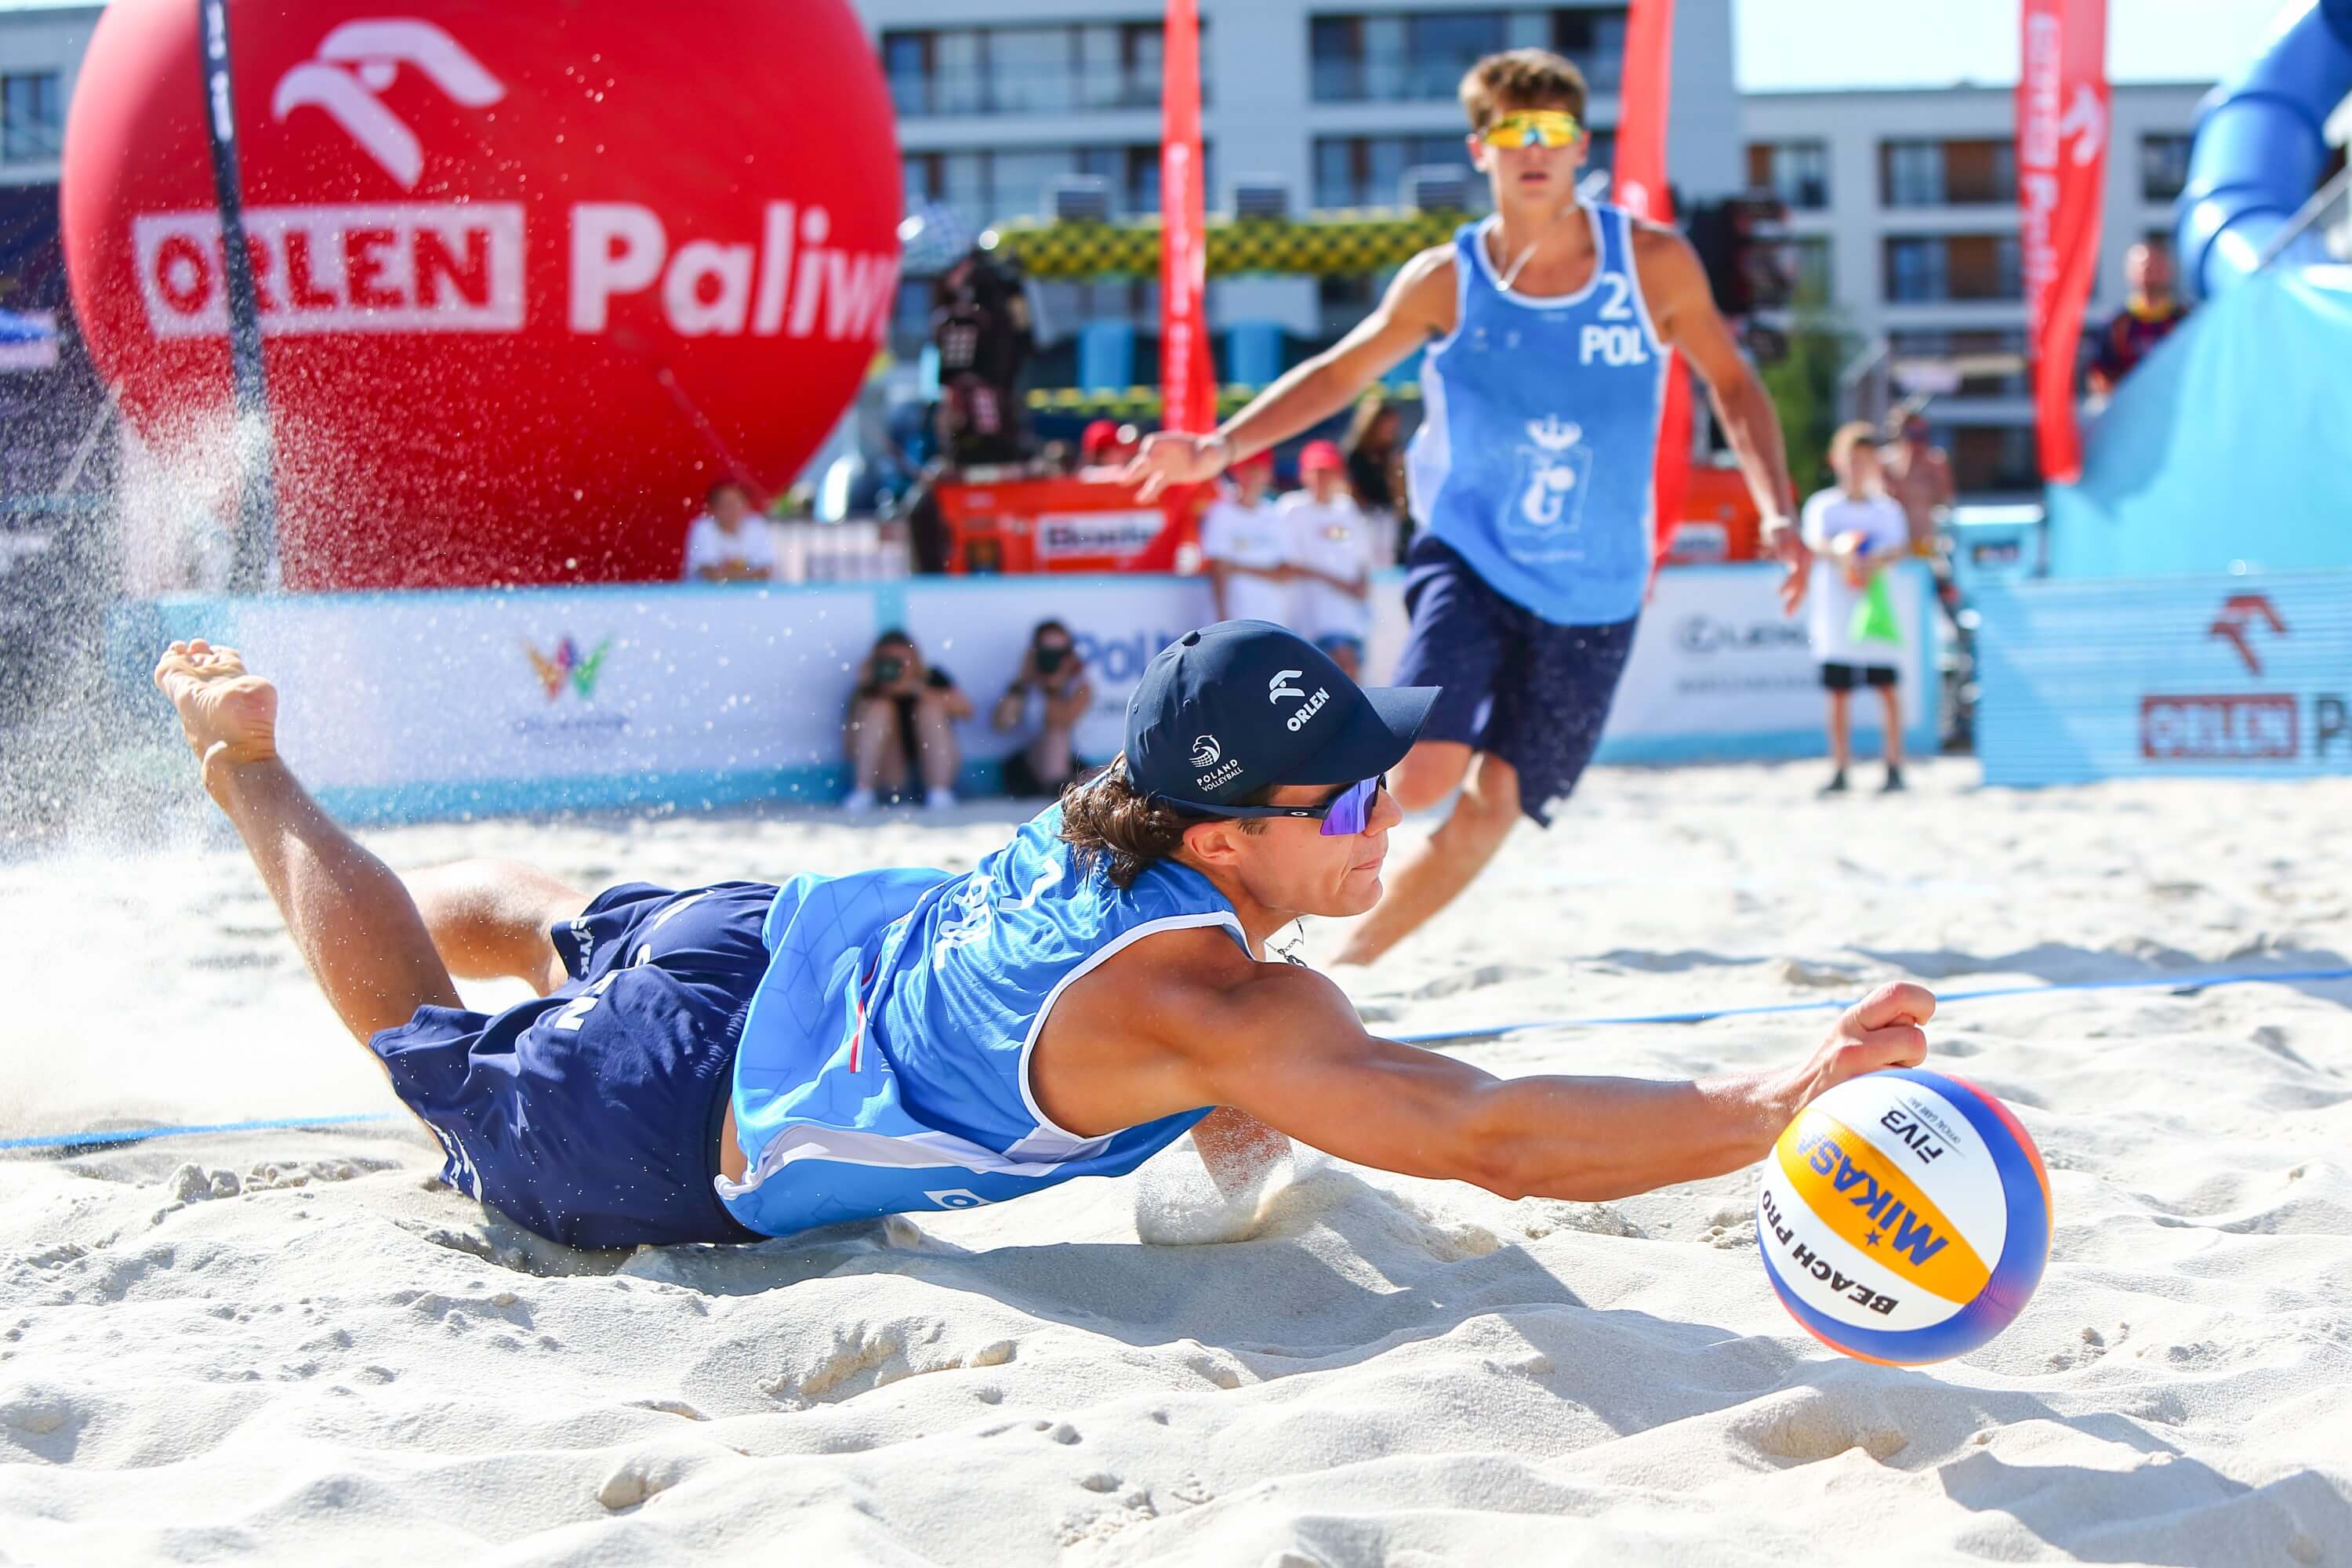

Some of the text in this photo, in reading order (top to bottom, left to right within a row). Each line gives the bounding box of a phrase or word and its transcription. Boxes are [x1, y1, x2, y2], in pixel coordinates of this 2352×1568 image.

[1598, 270, 1632, 322] 2
[1578, 324, 1650, 367] POL
[1286, 686, 1330, 732] ORLEN
[1196, 758, 1238, 786] POLAND
[1201, 767, 1244, 793] VOLLEYBALL
[1880, 1109, 1944, 1164] FIVB
[1762, 1189, 1900, 1316] BEACH PRO
